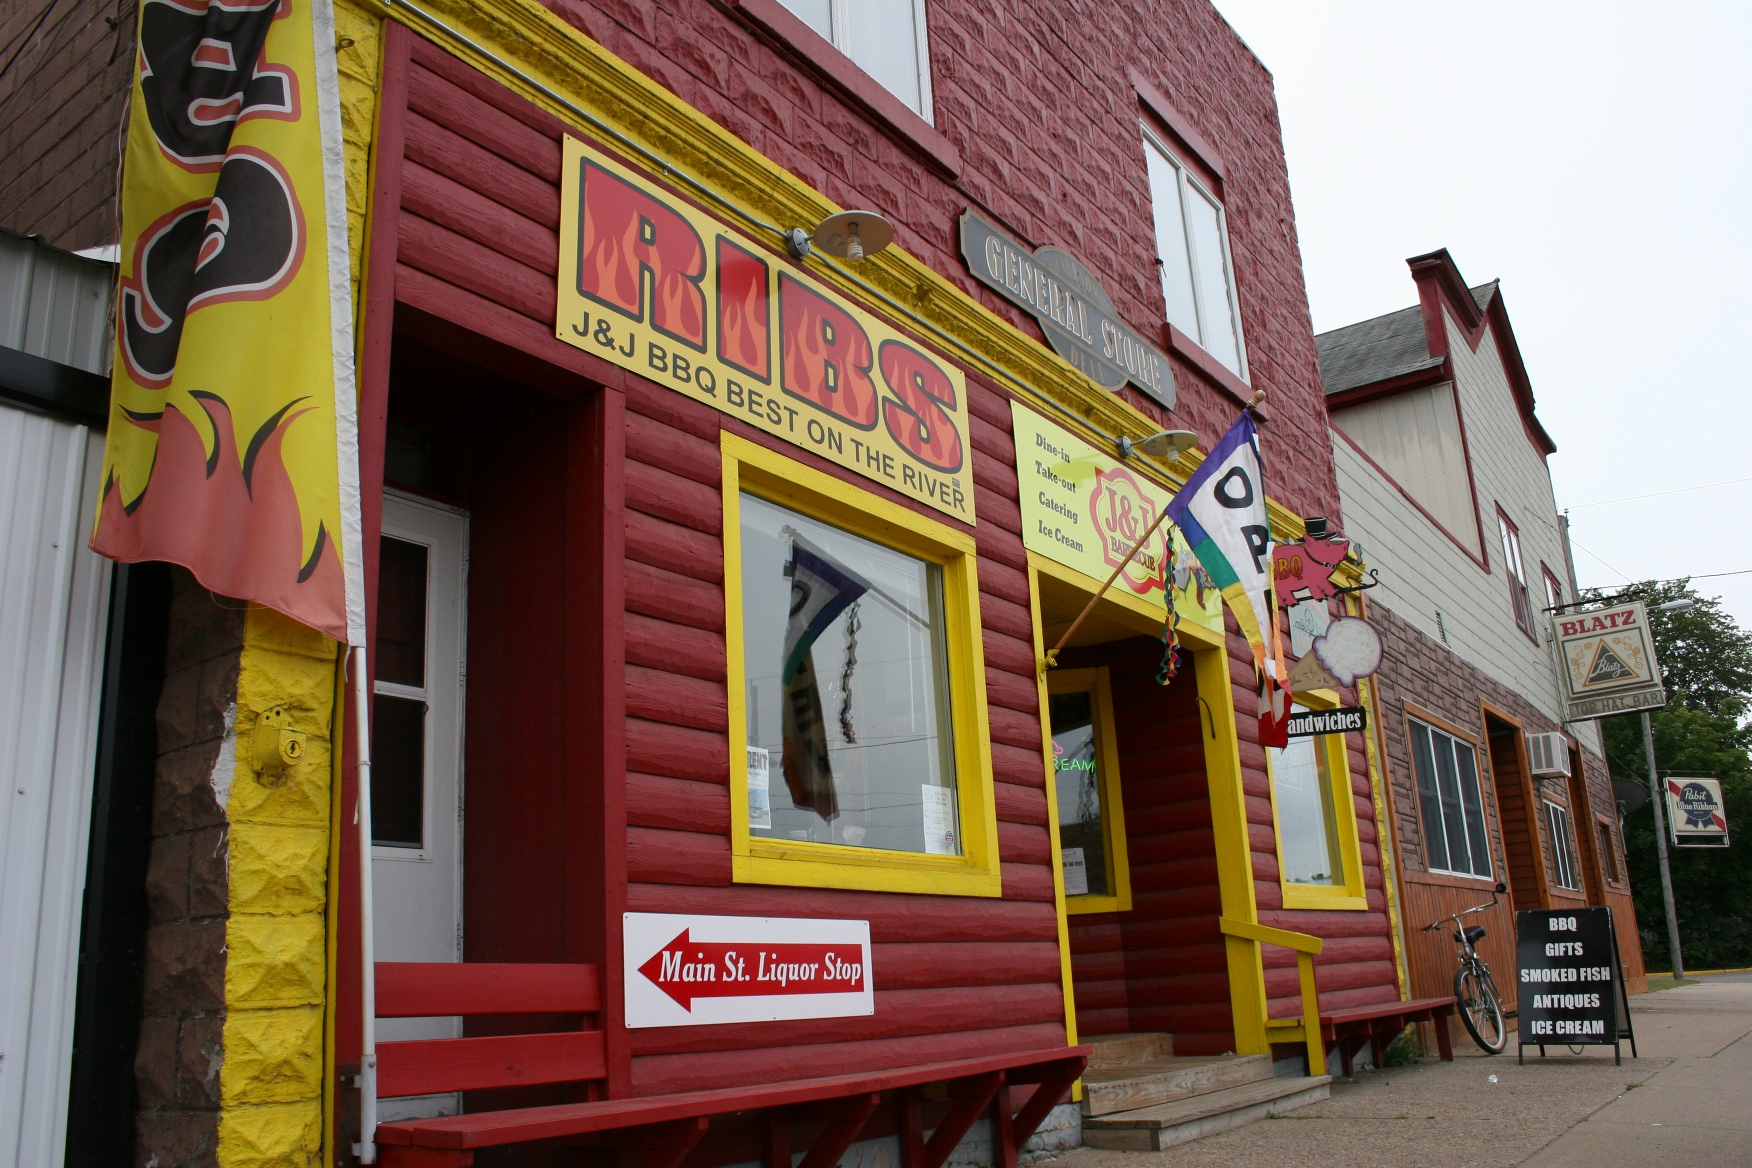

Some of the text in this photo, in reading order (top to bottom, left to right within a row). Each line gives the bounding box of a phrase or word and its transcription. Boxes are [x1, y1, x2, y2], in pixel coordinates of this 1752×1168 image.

[576, 155, 963, 474] RIBS
[985, 235, 1162, 393] GENERAL STORE
[1070, 343, 1104, 383] DELI
[572, 311, 967, 513] J&J BBQ BEST ON THE RIVER
[1035, 432, 1071, 464] Dine-in
[1035, 460, 1077, 493] Take-out
[1038, 491, 1079, 524] Catering
[1105, 486, 1150, 550] J&J
[1038, 520, 1084, 553] Ice Cream
[1110, 535, 1156, 572] BARECUE
[1559, 610, 1637, 637] BLATZ
[1591, 653, 1629, 677] Blatz
[1574, 693, 1659, 716] TOP HAT BAR
[1287, 711, 1361, 735] andwiches
[1053, 755, 1096, 773] REAM
[1677, 801, 1718, 811] Blue Ribbon
[1683, 788, 1707, 800] Pabst
[1549, 916, 1577, 931] BBQ
[1545, 942, 1584, 956] GIFTS
[658, 950, 861, 987] Main St. Liquor Stop
[1520, 967, 1610, 983] SMOKED FISH
[1533, 993, 1600, 1009] ANTIQUES
[1531, 1020, 1604, 1035] ICE CREAM
